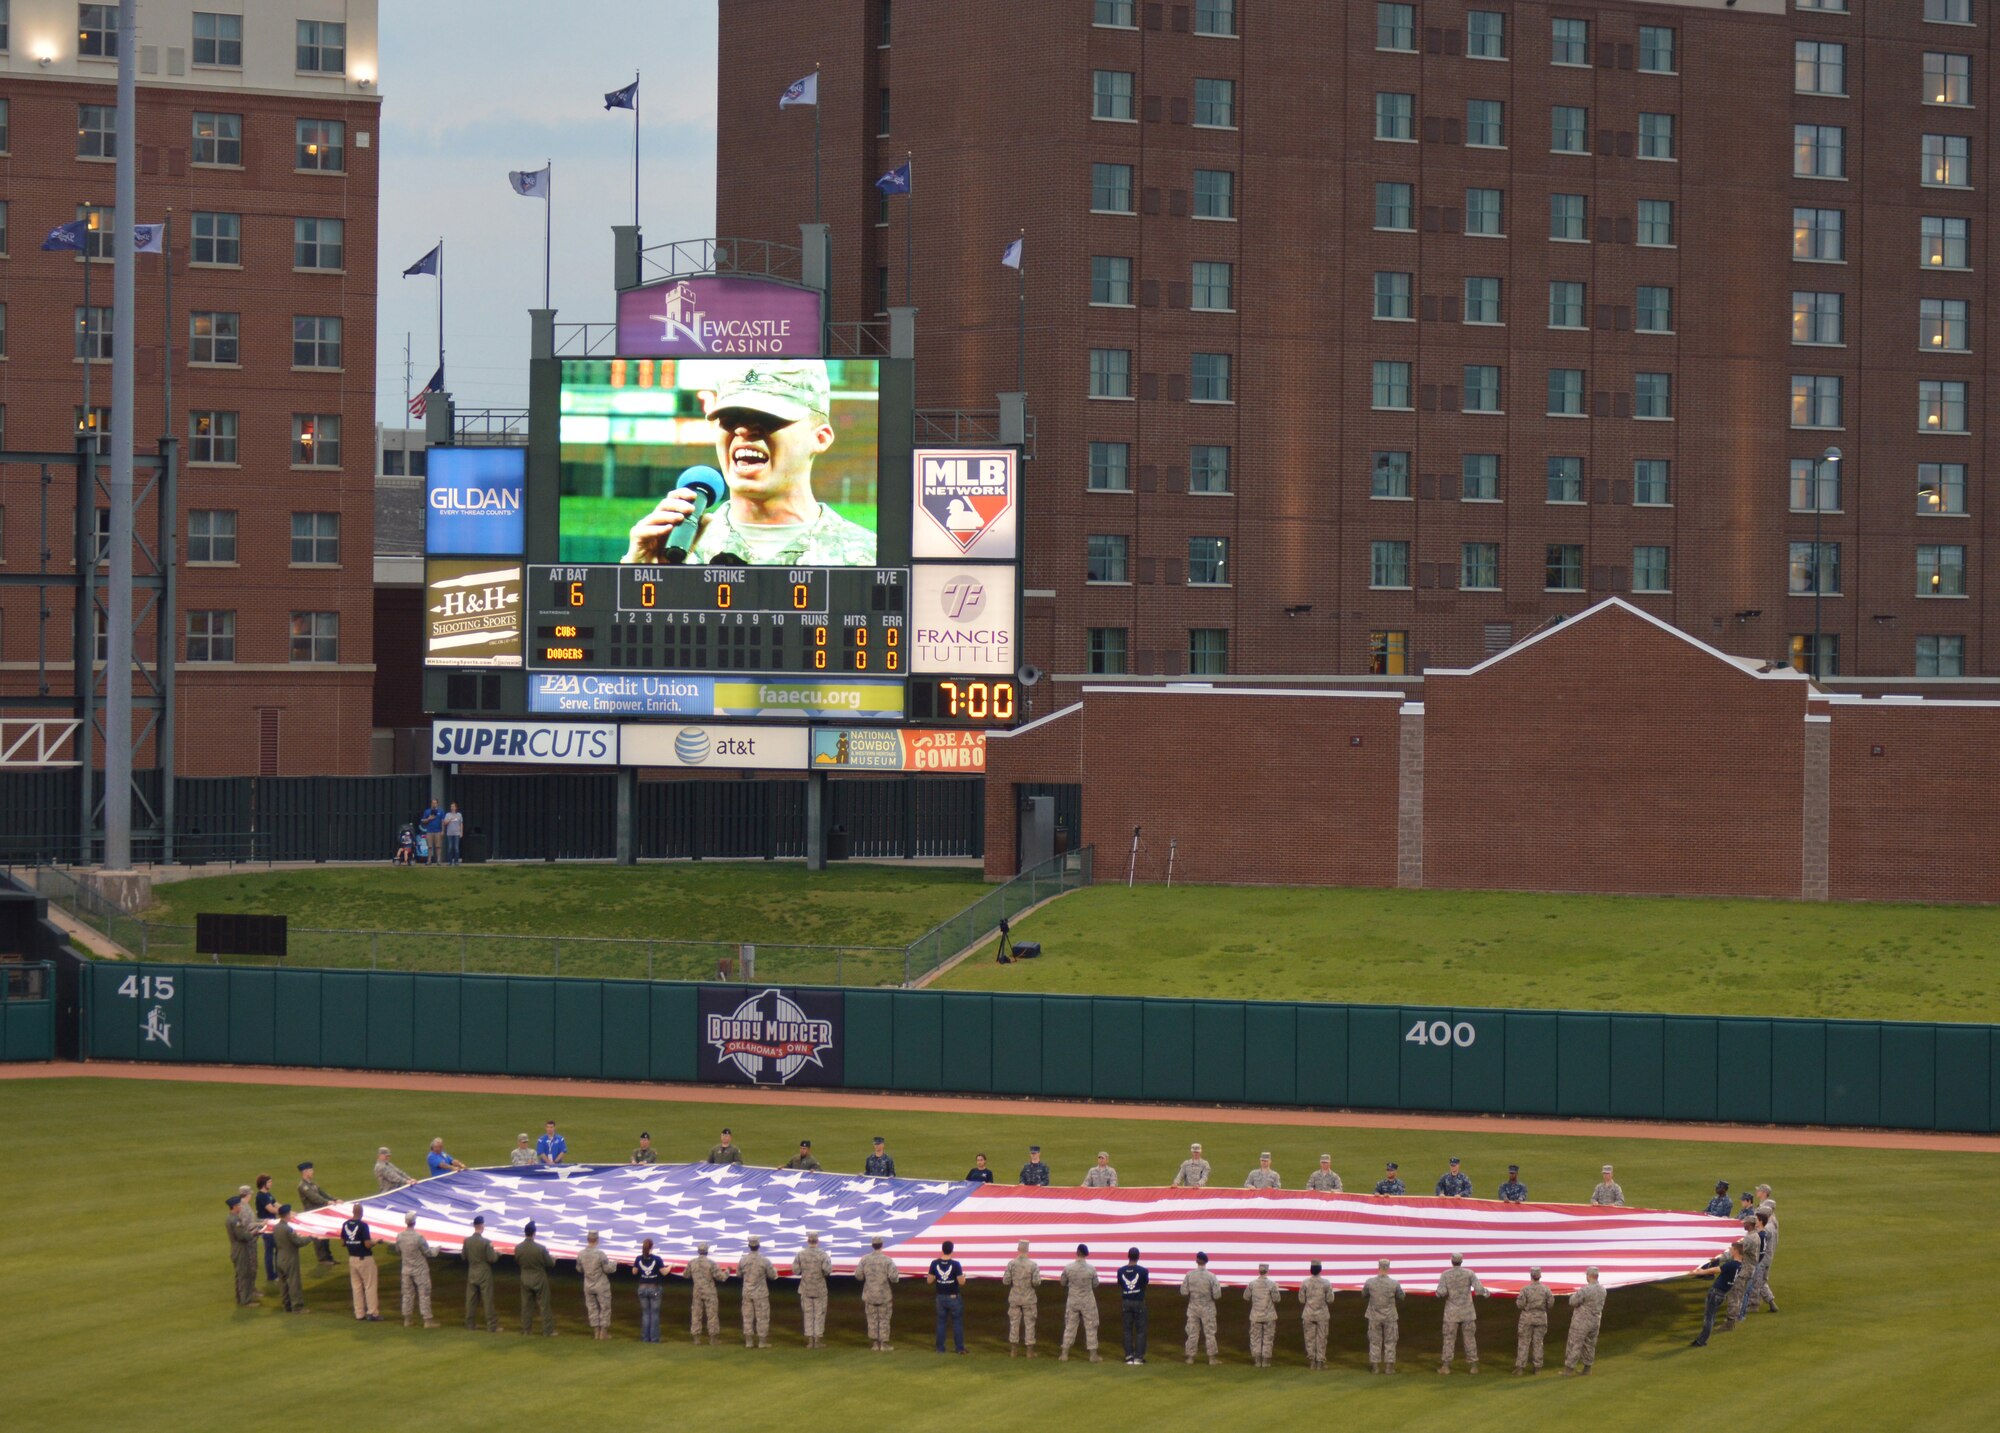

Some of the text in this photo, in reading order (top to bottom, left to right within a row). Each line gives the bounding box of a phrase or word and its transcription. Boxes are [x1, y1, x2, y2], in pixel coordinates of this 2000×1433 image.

[648, 303, 790, 351] NEWCASTLE
[711, 338, 782, 352] CASINO
[925, 459, 1006, 486] MLB
[430, 487, 519, 509] GILDAN
[925, 486, 1006, 496] NETWORK
[549, 569, 588, 581] AT BAT
[634, 569, 663, 582] BALL
[704, 570, 745, 583] STRIKE
[789, 570, 813, 583] OUT
[876, 571, 897, 585] H/E
[443, 586, 506, 617] H&H
[570, 582, 584, 606] 6
[641, 583, 655, 607] 0
[717, 584, 731, 608] 0
[794, 584, 807, 609] 0
[433, 615, 516, 634] SHOOTING SPORTS
[614, 613, 902, 627] 1 2 3 4 5 6 7 8 9 10 RUNS HITS ERR
[555, 626, 898, 646] CUBS 0 0 0
[917, 629, 1009, 644] FRANCIS
[547, 648, 897, 670] DODGERS 0 0 0
[917, 645, 1009, 662] TUTTLE
[541, 675, 699, 696] FAA Credit Union
[560, 697, 681, 713] Serve. Empower. Enrich.
[759, 686, 861, 707] faaecu.org
[940, 683, 1012, 718] 7:00
[436, 727, 608, 758] SUPERCUTS
[850, 731, 896, 740] NATIONAL
[934, 732, 975, 747] BE A
[716, 737, 756, 755] at&t
[850, 740, 896, 751] COWBOY
[850, 757, 896, 766] MUSEUM
[118, 975, 175, 1000] 415
[711, 1018, 828, 1043] BOBBY MURCER
[1405, 1020, 1476, 1047] 400
[729, 1042, 808, 1056] OKLAHOMA'S OWN
